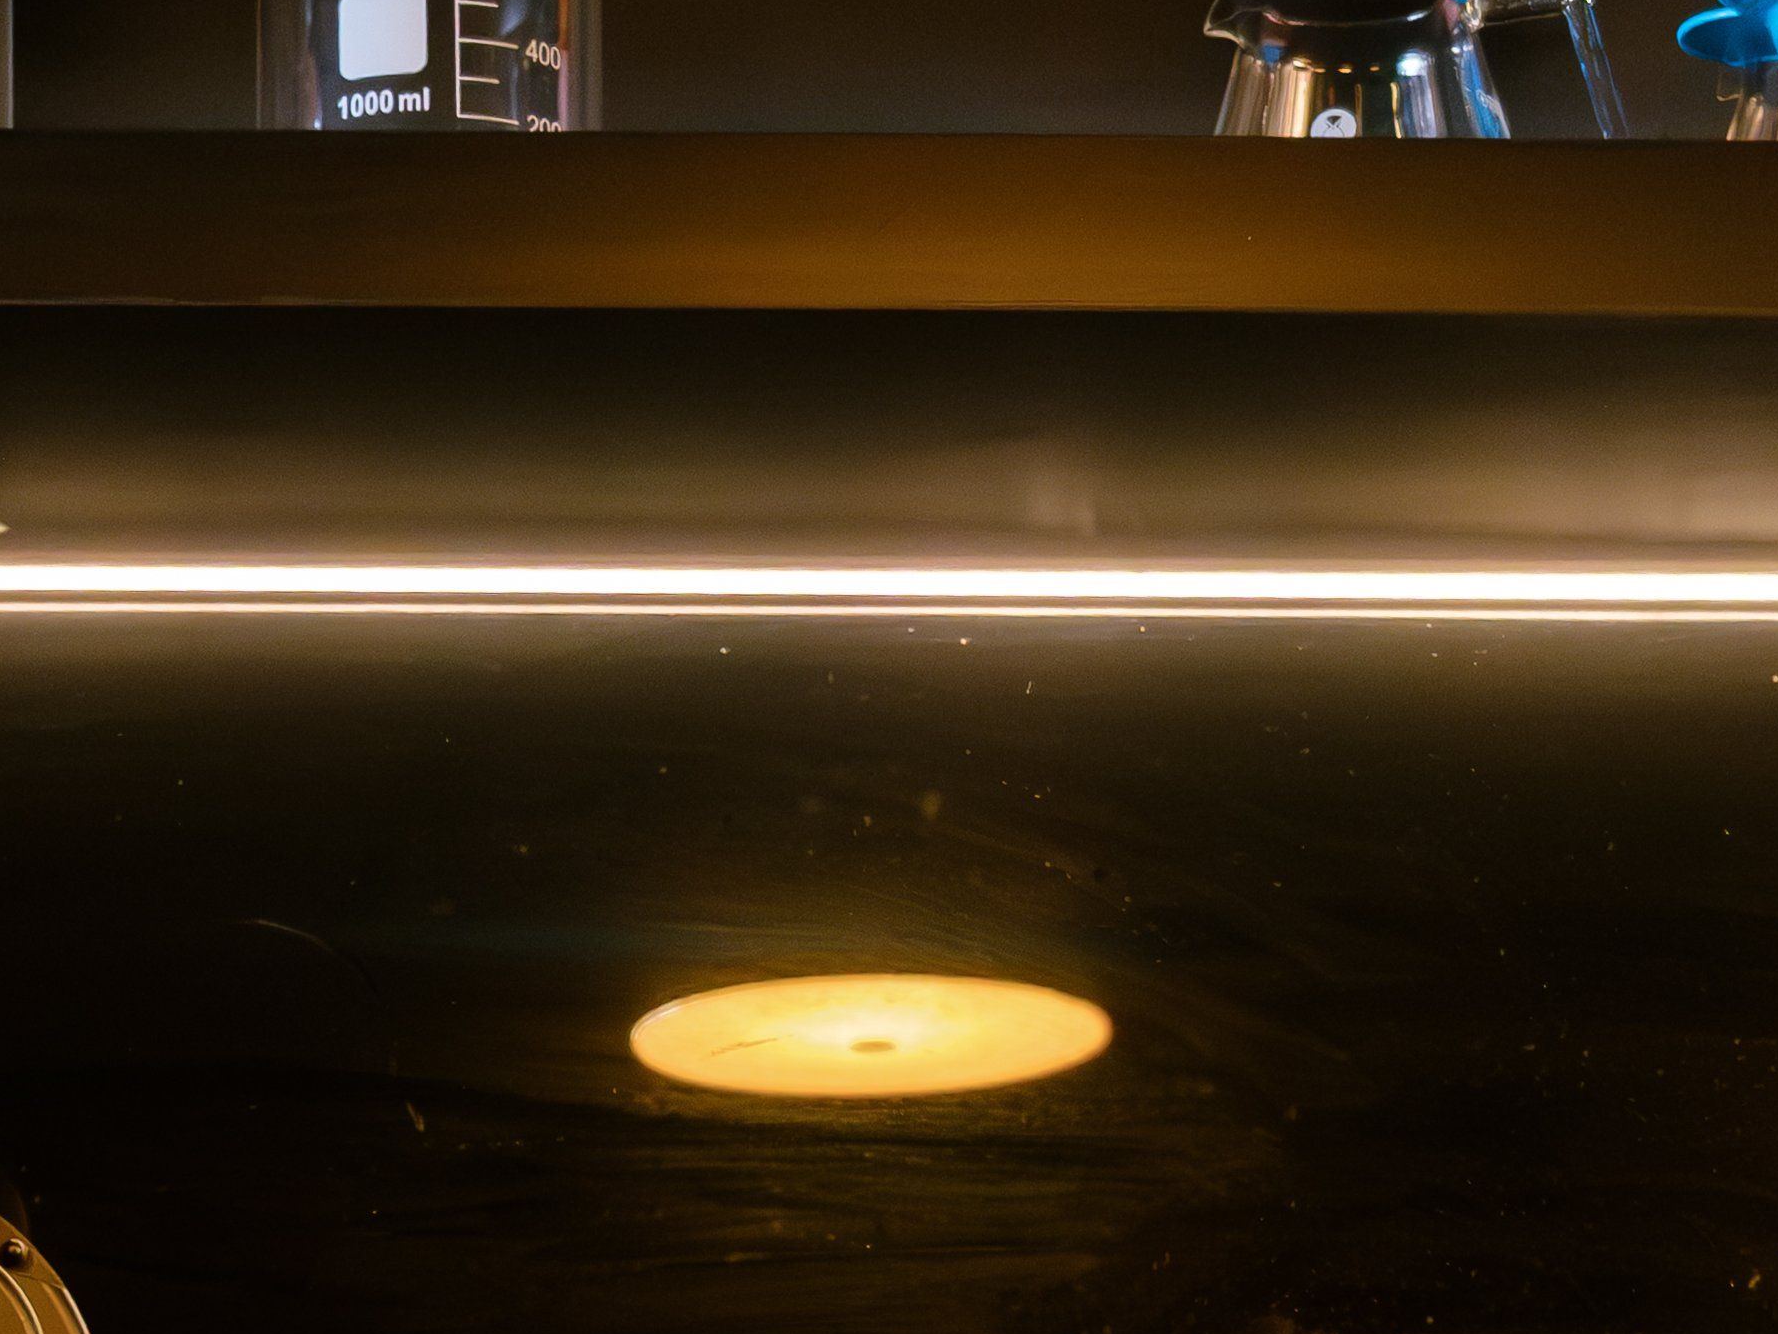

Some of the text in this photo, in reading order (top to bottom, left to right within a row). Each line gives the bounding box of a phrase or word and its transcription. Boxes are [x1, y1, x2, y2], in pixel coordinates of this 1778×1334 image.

[525, 39, 561, 70] 400
[337, 87, 430, 119] 1000 ml
